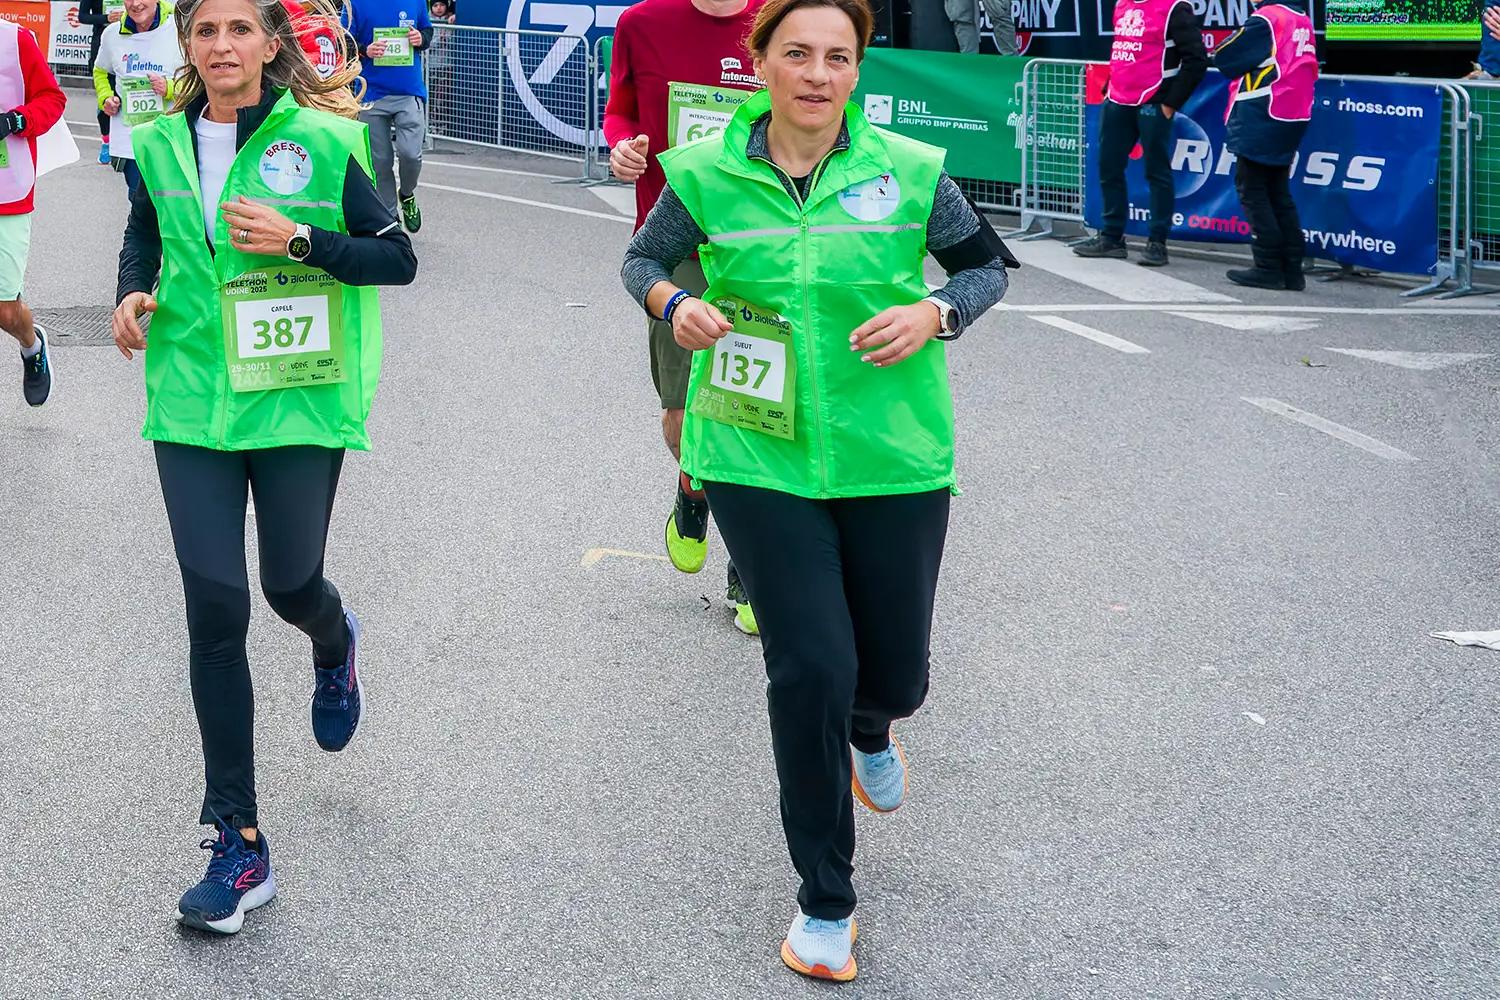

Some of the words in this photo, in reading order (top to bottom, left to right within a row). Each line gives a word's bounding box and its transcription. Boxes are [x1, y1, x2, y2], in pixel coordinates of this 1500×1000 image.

[1112, 51, 1136, 62] GARA
[674, 91, 707, 100] TELETHON
[132, 99, 157, 112] 902
[898, 100, 931, 115] BNL
[1338, 96, 1424, 118] rhoss.com
[689, 113, 725, 123] INTERCULTURA
[897, 117, 931, 127] GRUPPO
[933, 119, 954, 129] BNP
[956, 121, 988, 132] PARIBAS
[265, 142, 307, 162] BRESSA
[226, 278, 268, 288] TELETHON
[253, 316, 314, 350] 387
[231, 361, 271, 373] 29-30/11
[720, 351, 772, 390] 137
